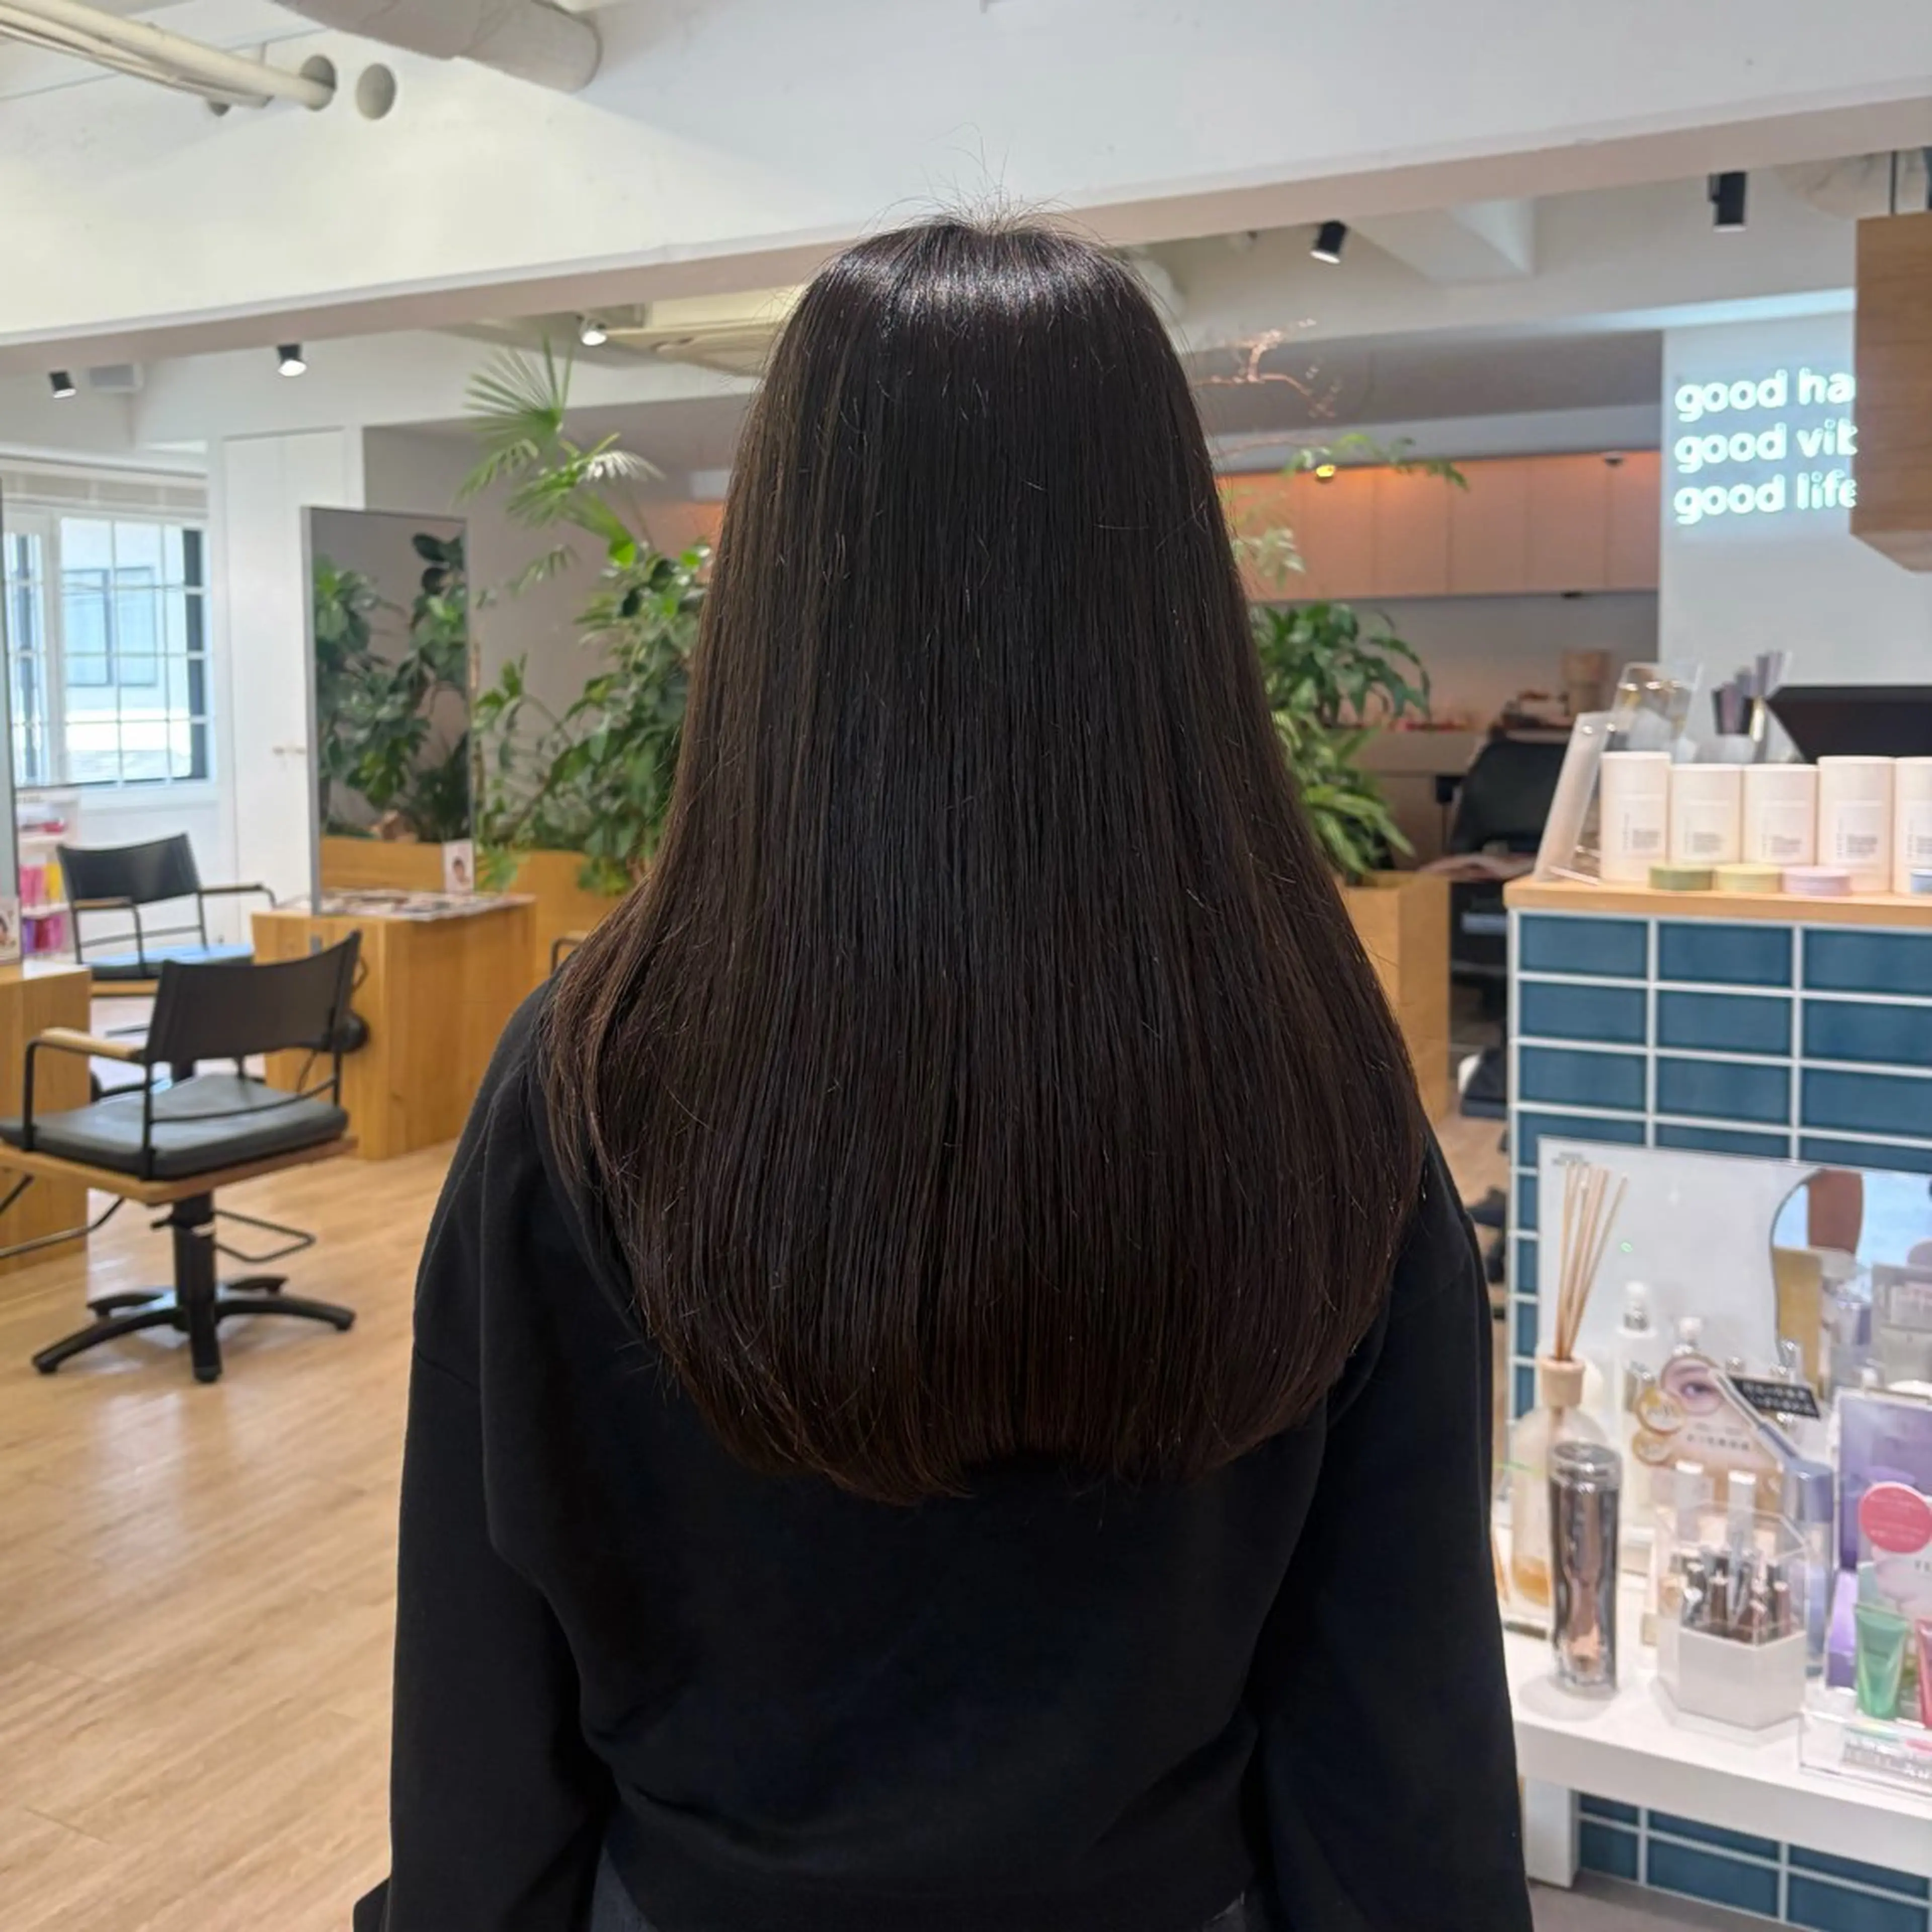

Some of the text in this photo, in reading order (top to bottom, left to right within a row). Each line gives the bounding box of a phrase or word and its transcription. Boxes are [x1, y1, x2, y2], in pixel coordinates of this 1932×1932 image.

[1674, 369, 1788, 422] good
[1674, 422, 1787, 473] good
[1673, 474, 1786, 525] good
